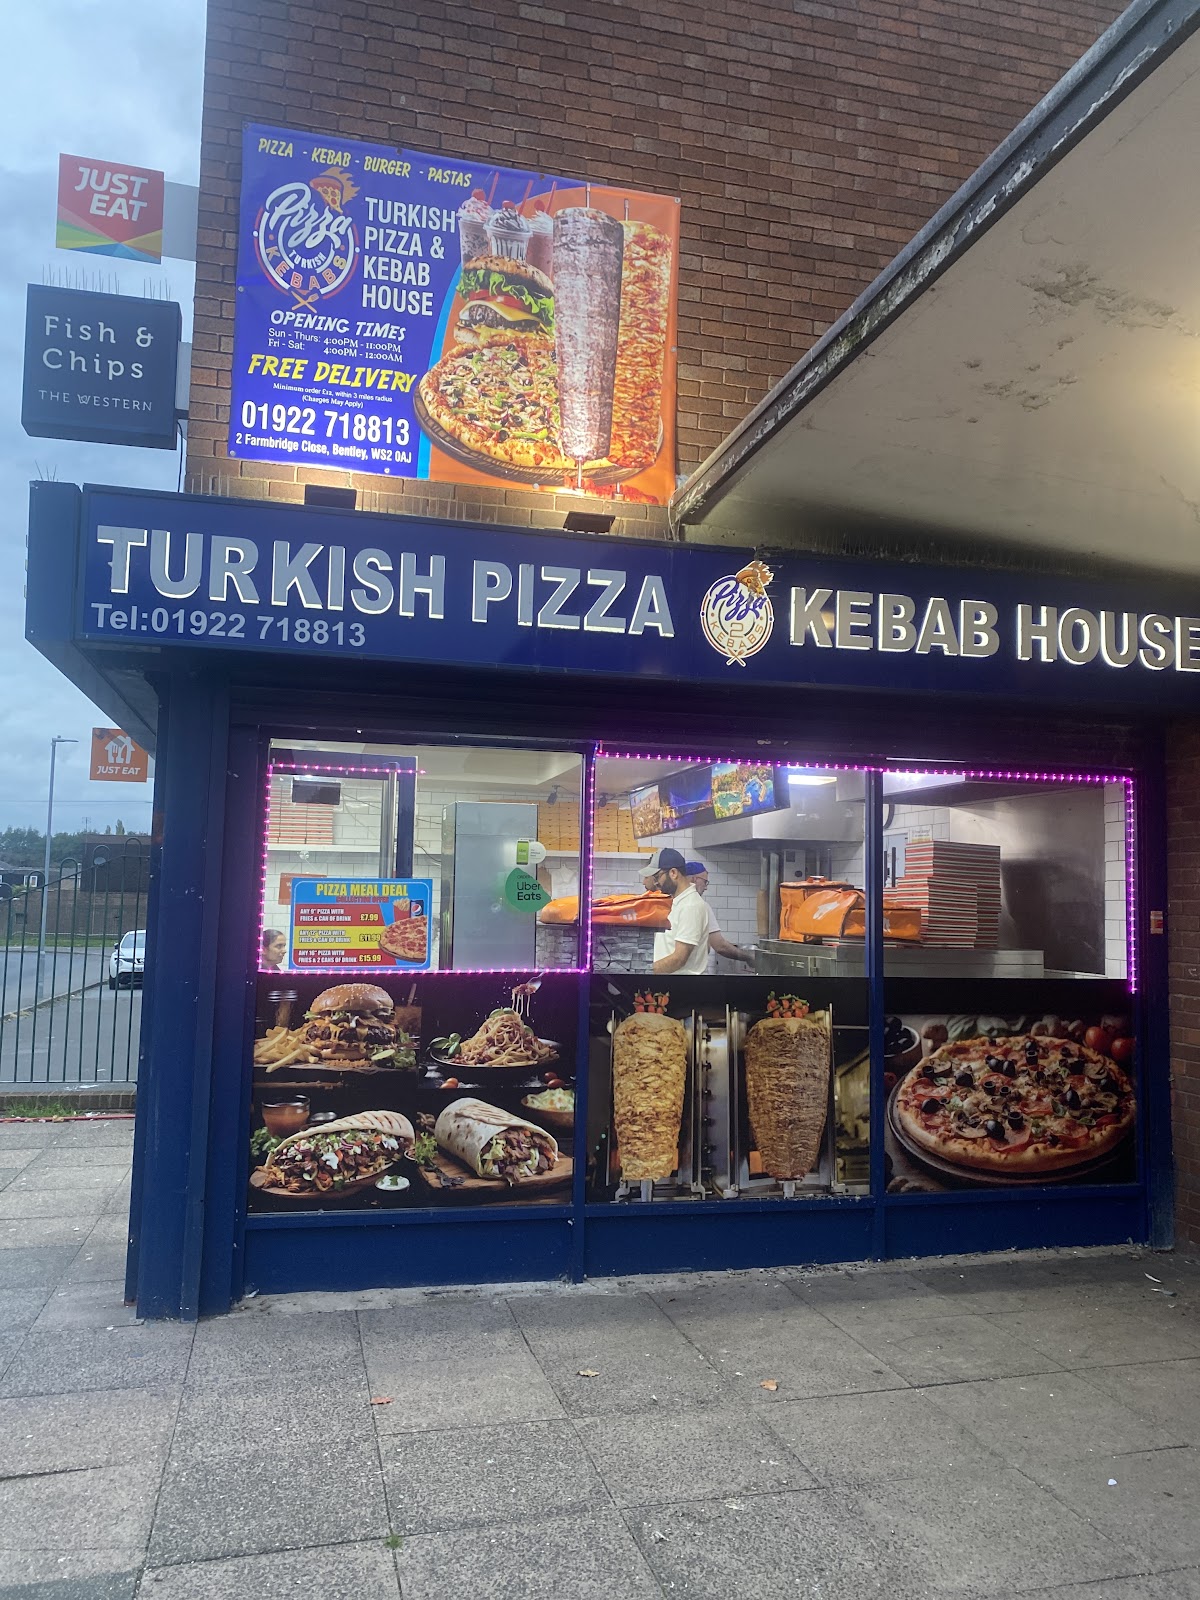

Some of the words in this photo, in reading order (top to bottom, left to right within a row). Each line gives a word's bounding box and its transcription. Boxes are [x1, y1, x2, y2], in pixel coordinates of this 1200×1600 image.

[259, 138, 293, 158] PIZZA
[311, 147, 351, 168] KEBAB
[364, 156, 411, 178] BURGER
[428, 167, 472, 187] PASTAS
[75, 166, 148, 197] JUST
[89, 193, 147, 221] EAT
[266, 182, 352, 249] Pizza
[365, 197, 456, 233] TURKISH
[365, 226, 423, 257] PIZZA
[430, 235, 445, 259] &
[266, 246, 346, 290] KEBABS
[289, 249, 326, 269] TURKISH
[364, 255, 430, 286] KEBAB
[362, 284, 434, 316] HOUSE
[45, 315, 116, 344] Fish
[136, 326, 154, 348] &
[268, 328, 286, 338] Sun
[294, 331, 321, 343] Thurs:
[324, 337, 358, 348] 4:00PM
[366, 342, 401, 353] 11:00PM
[270, 310, 349, 334] OPENING
[355, 321, 406, 341] TIMES
[42, 348, 144, 380] Chips
[268, 338, 280, 347] Fri
[288, 340, 305, 350] Sat:
[323, 347, 357, 357] 4:00PM
[365, 352, 403, 363] 12:00AM
[248, 354, 308, 380] FREE
[313, 362, 417, 393] DELIVERY
[38, 389, 70, 403] THE
[77, 394, 152, 411] WESTERN
[273, 382, 304, 393] Minimum
[305, 387, 321, 395] order
[335, 390, 352, 399] within
[359, 393, 374, 401] miles
[375, 395, 393, 403] radius
[302, 394, 330, 405] (Charges
[331, 397, 344, 407] May
[345, 399, 364, 409] Apply)
[241, 400, 316, 436] 01922
[323, 410, 410, 446] 718813
[235, 432, 242, 445] 2
[244, 433, 299, 452] Farmbridge
[301, 440, 330, 456] Close,
[332, 443, 368, 461] Bentley,
[371, 447, 392, 461] WS2
[97, 525, 446, 620] TURKISH
[471, 559, 675, 638] PIZZA
[789, 587, 1001, 658] KEBAB
[1016, 603, 1200, 673] HOUSE
[710, 576, 767, 621] Pizza
[91, 602, 246, 638] Tel:01922
[256, 615, 366, 648] 718813
[710, 621, 764, 650] KEBABS
[96, 765, 120, 775] JUST
[122, 767, 141, 775] EAT
[316, 883, 347, 896] PIZZA
[350, 884, 379, 896] MEAL
[382, 884, 408, 897] DEAL
[516, 882, 541, 891] Uber
[517, 892, 542, 901] Eats
[360, 913, 379, 921] £7.99
[359, 934, 381, 942] £11.99
[358, 954, 382, 962] £15.99
